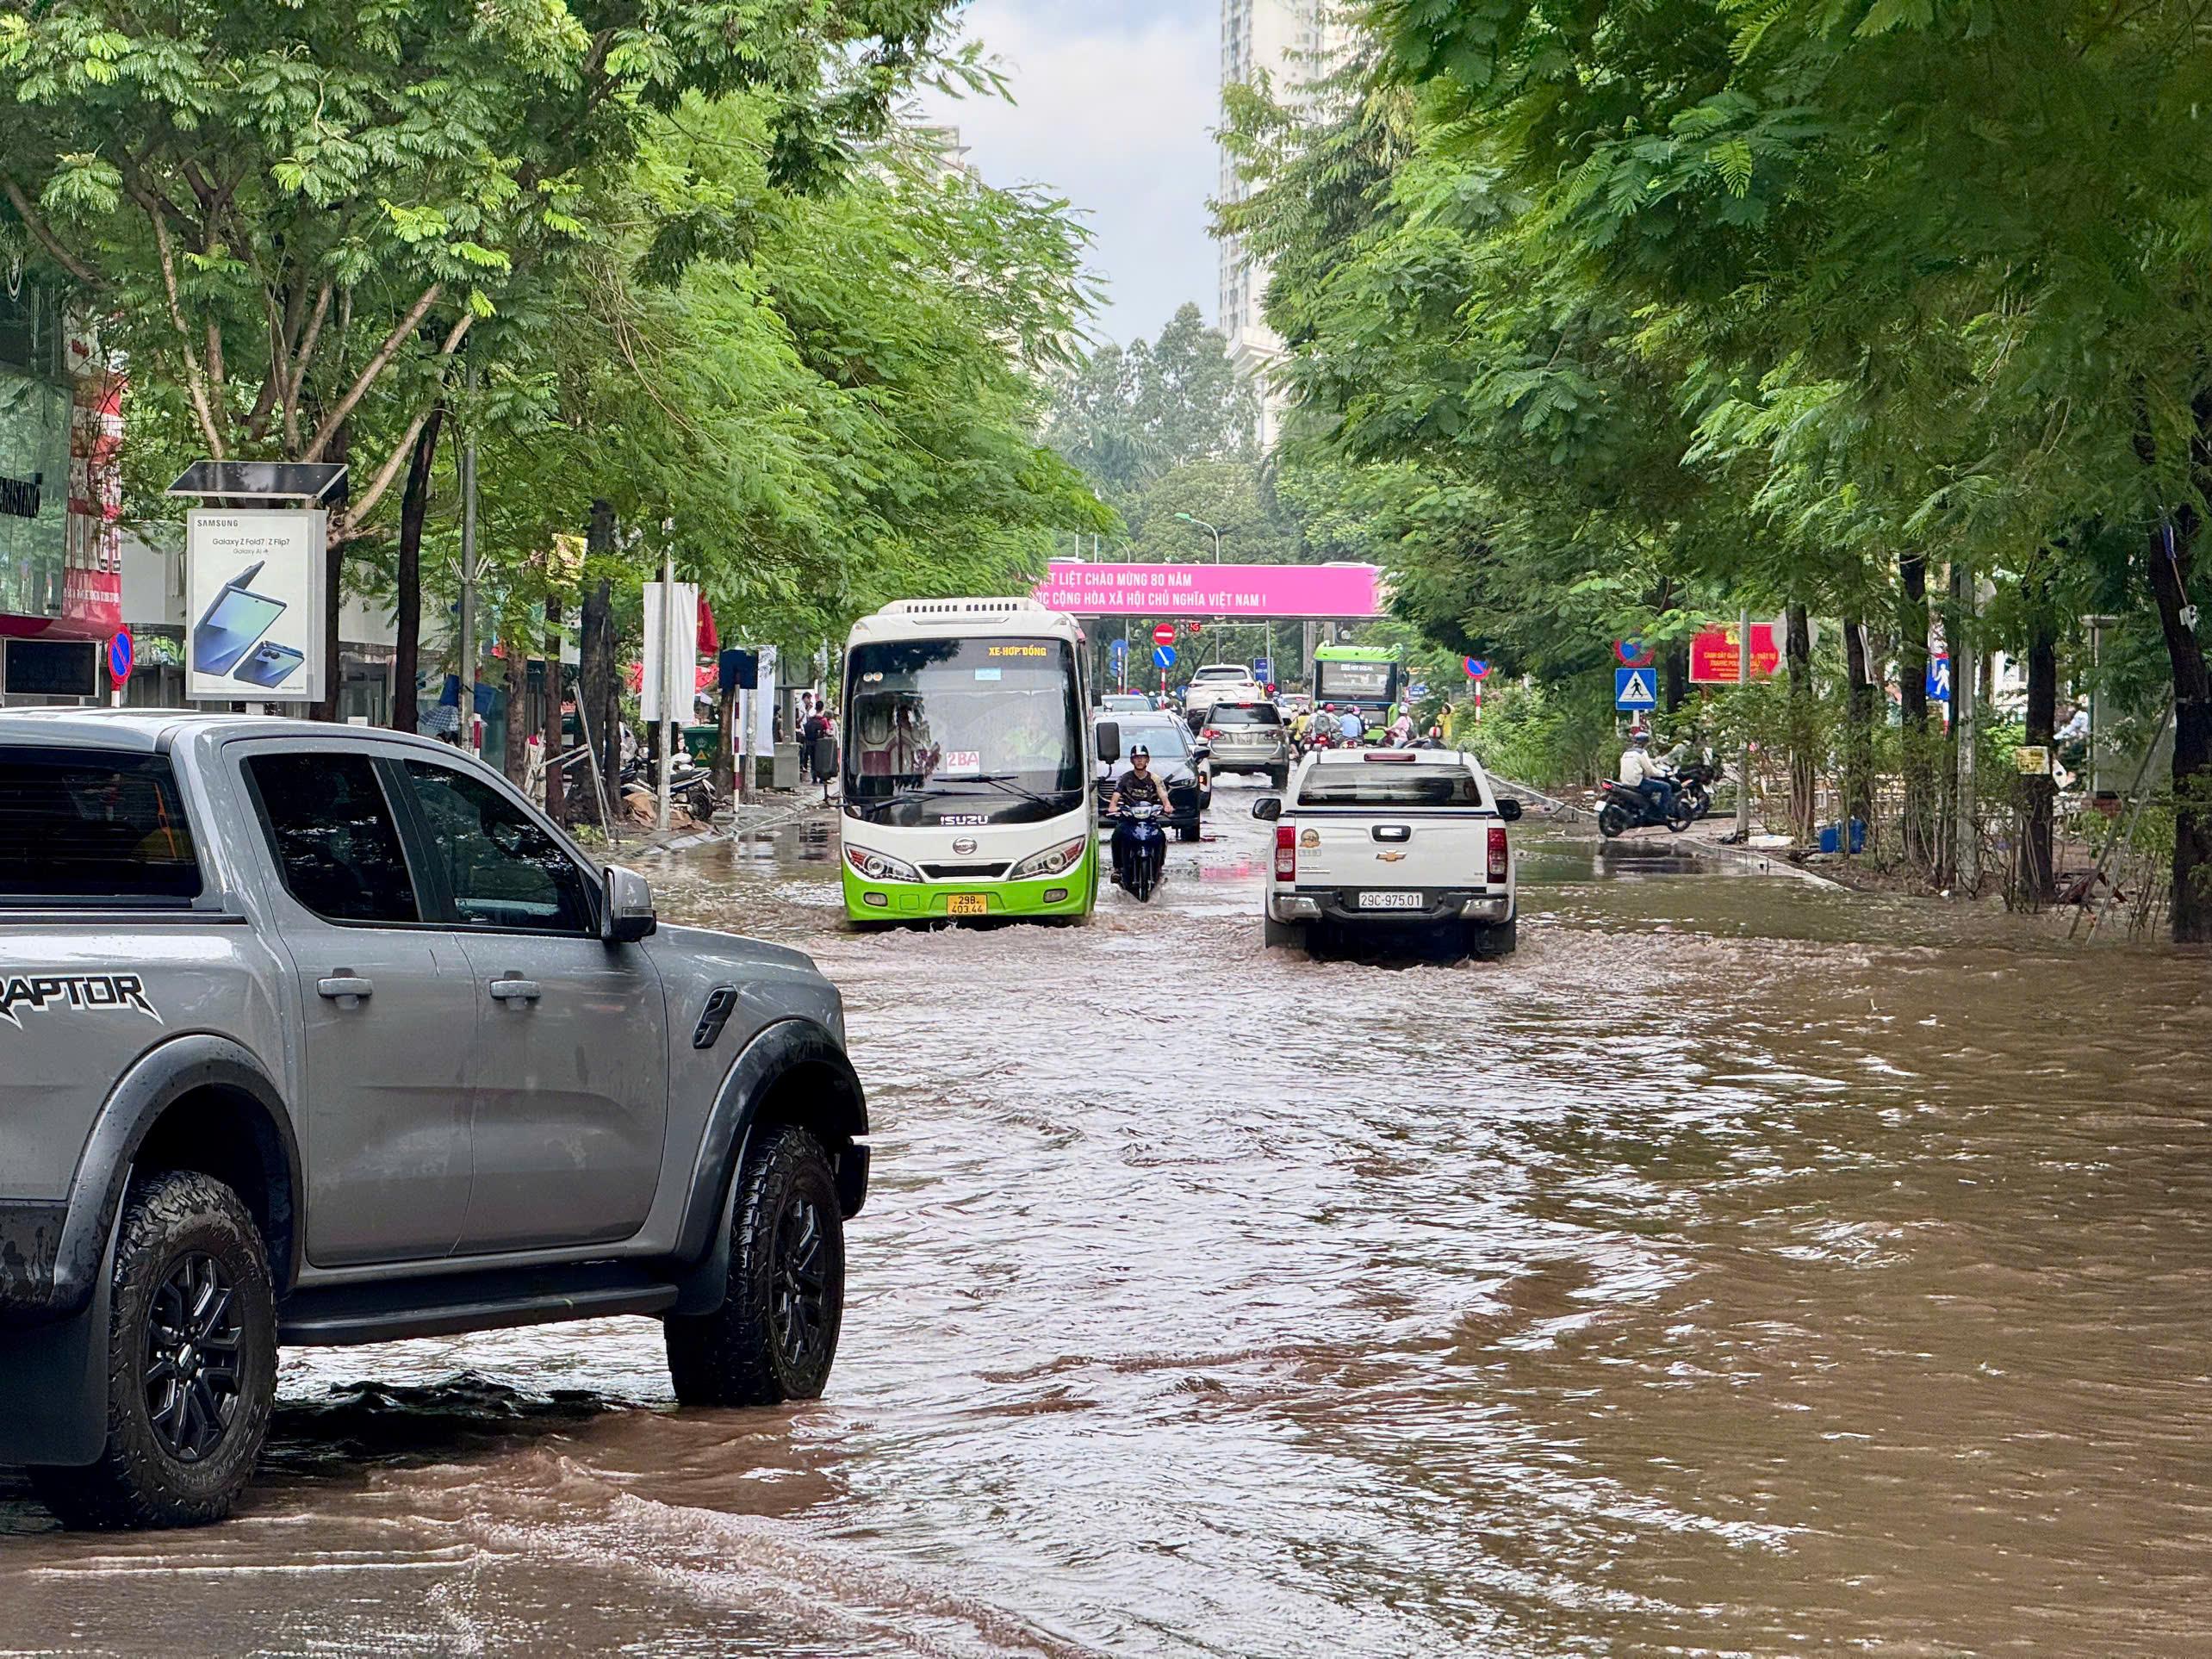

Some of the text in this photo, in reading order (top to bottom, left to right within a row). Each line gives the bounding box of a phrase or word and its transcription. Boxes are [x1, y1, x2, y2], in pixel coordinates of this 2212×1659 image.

[212, 538, 239, 547] Galaxy
[274, 538, 290, 547] Flip7
[1059, 571, 1083, 587] LIỆT
[1085, 570, 1114, 586] CHÀO
[1116, 570, 1148, 587] MỪNG
[1150, 573, 1165, 587] 80
[1167, 572, 1192, 587] NĂM
[1053, 589, 1081, 606] CỘNG
[1084, 589, 1106, 606] HÒA
[1109, 590, 1124, 606] XÃ
[1127, 590, 1145, 607] HỘI
[1148, 589, 1169, 606] CHỦ
[1172, 591, 1205, 606] NGHĨA
[1209, 591, 1233, 609] VIỆT
[1235, 593, 1259, 606] NAM
[940, 815, 989, 825] ISUZU
